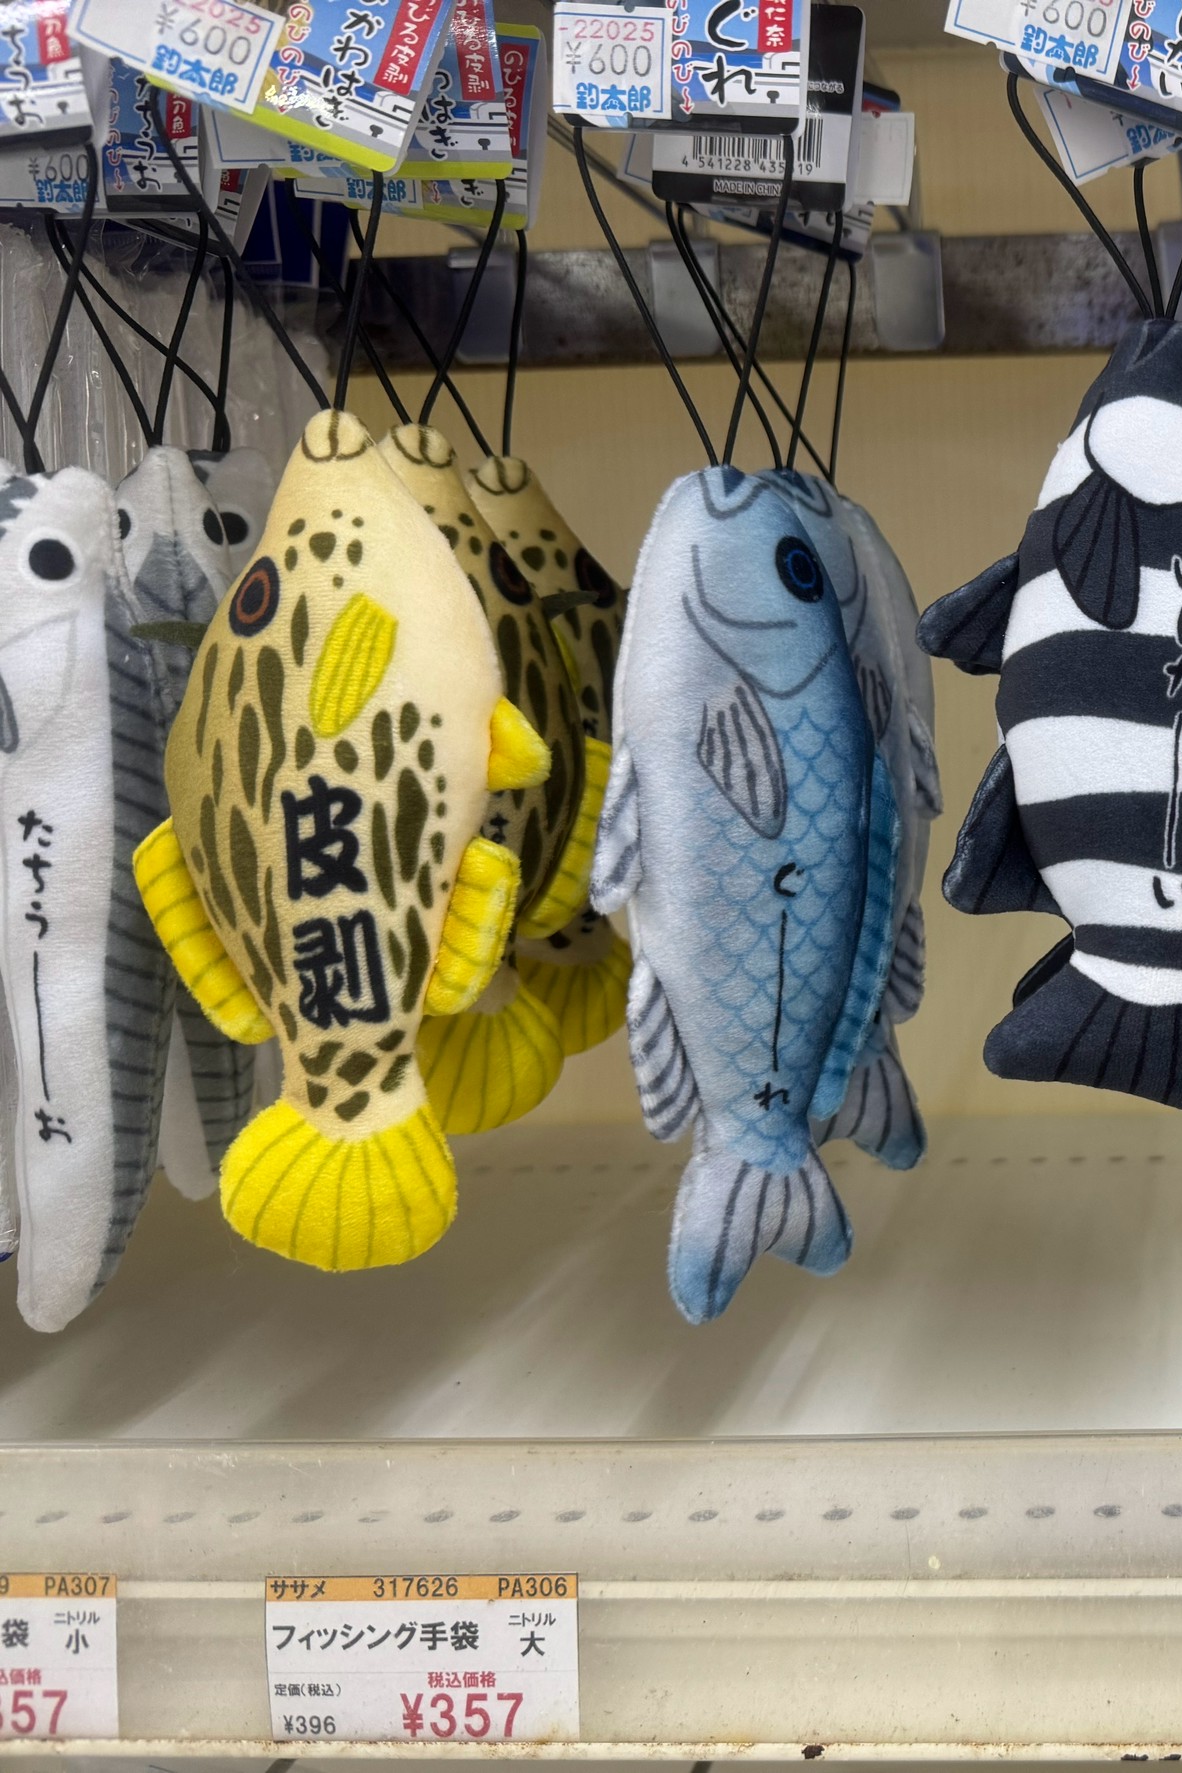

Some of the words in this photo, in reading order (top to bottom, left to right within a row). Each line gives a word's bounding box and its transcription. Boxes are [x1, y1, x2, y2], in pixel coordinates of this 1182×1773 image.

[155, 3, 252, 65] ¥600
[1020, 23, 1100, 69] 釣太郎
[151, 44, 239, 95] 釣太郎
[565, 41, 652, 77] ¥600
[576, 82, 652, 113] 釣太郎
[28, 153, 90, 182] ¥600
[714, 180, 742, 193] MADE
[744, 181, 755, 194] IN
[756, 182, 782, 196] CHIN
[281, 774, 390, 1030] 皮剥
[45, 1576, 110, 1596] PA307
[270, 1580, 326, 1598] ササメ
[373, 1577, 459, 1597] 317626
[498, 1577, 567, 1597] PA306
[54, 1611, 100, 1625] ニトリル
[509, 1612, 557, 1627] ニトリル
[66, 1629, 89, 1655] 小
[272, 1620, 480, 1651] フィッシング手袋
[520, 1631, 546, 1657] 大
[428, 1671, 497, 1688] 税込価格
[0, 1690, 68, 1735] 57
[283, 1715, 337, 1735] ¥396
[400, 1692, 524, 1738] ¥357
